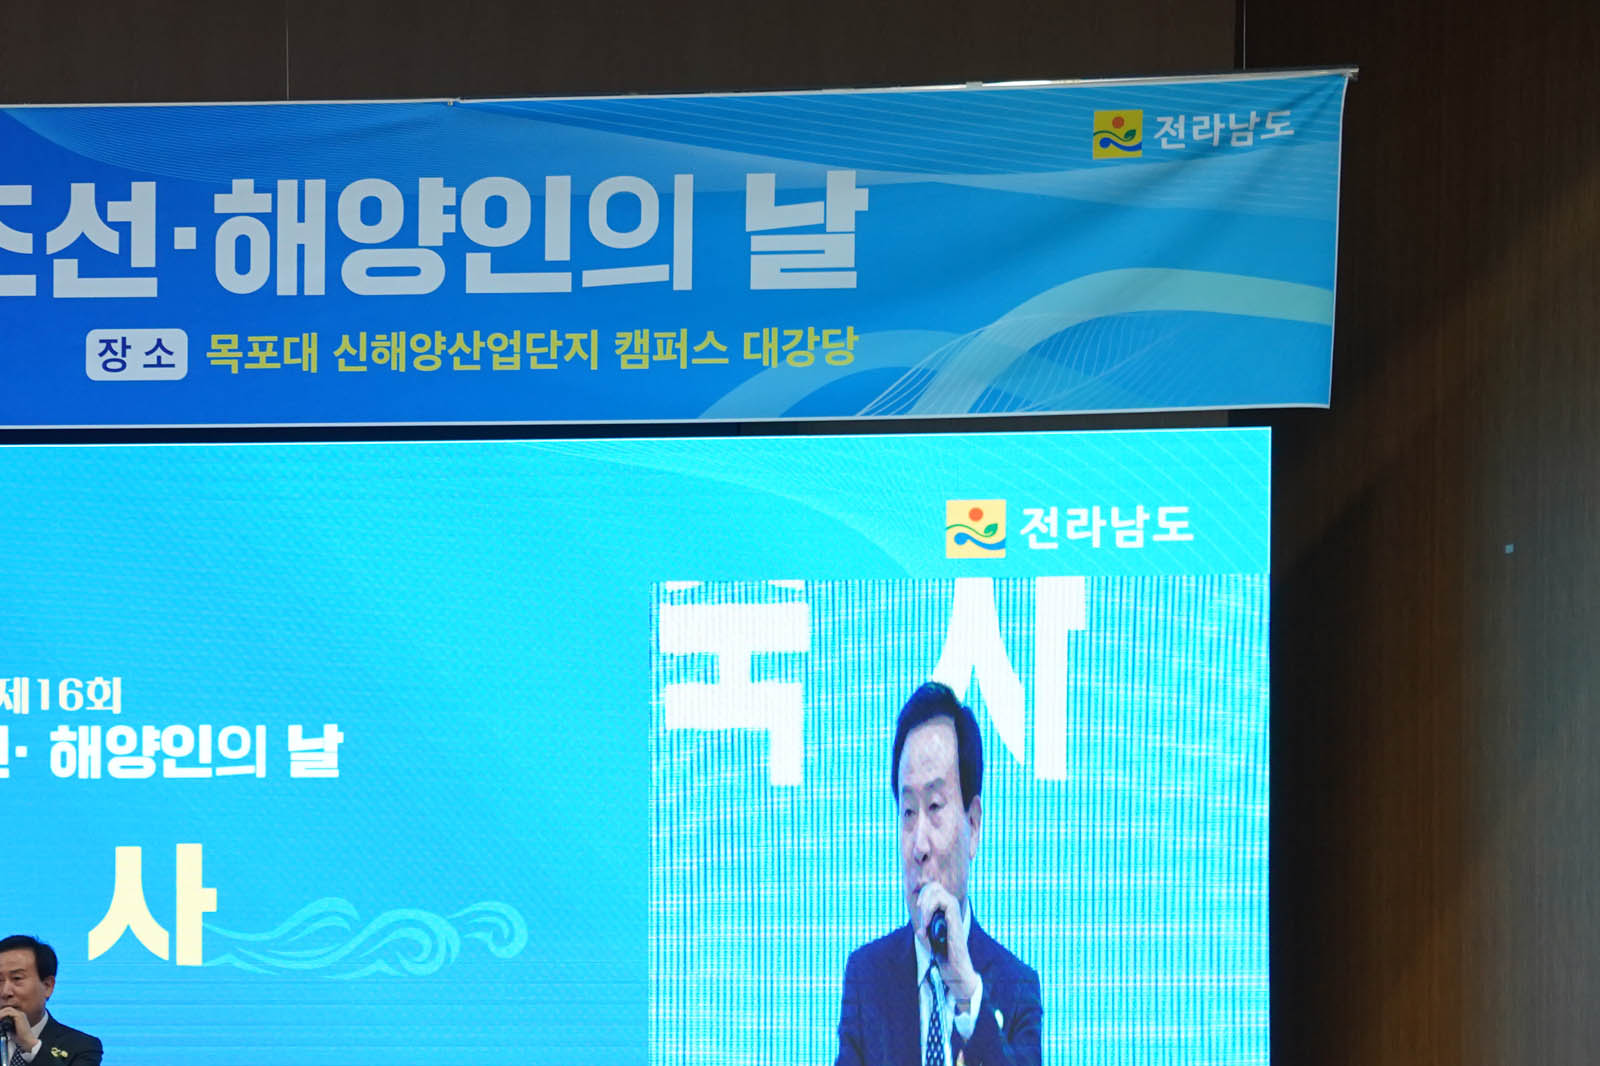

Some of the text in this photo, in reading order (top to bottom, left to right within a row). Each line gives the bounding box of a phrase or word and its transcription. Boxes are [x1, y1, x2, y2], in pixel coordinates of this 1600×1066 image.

[1154, 110, 1294, 149] 전라남도
[746, 170, 868, 290] 날
[206, 332, 318, 373] 목포대
[333, 330, 599, 372] 신해양산업단지
[615, 327, 729, 368] 캠퍼스
[744, 325, 858, 367] 대강당
[1020, 505, 1194, 549] 전라남도
[49, 724, 266, 779] 해양인의
[288, 723, 344, 779] 날
